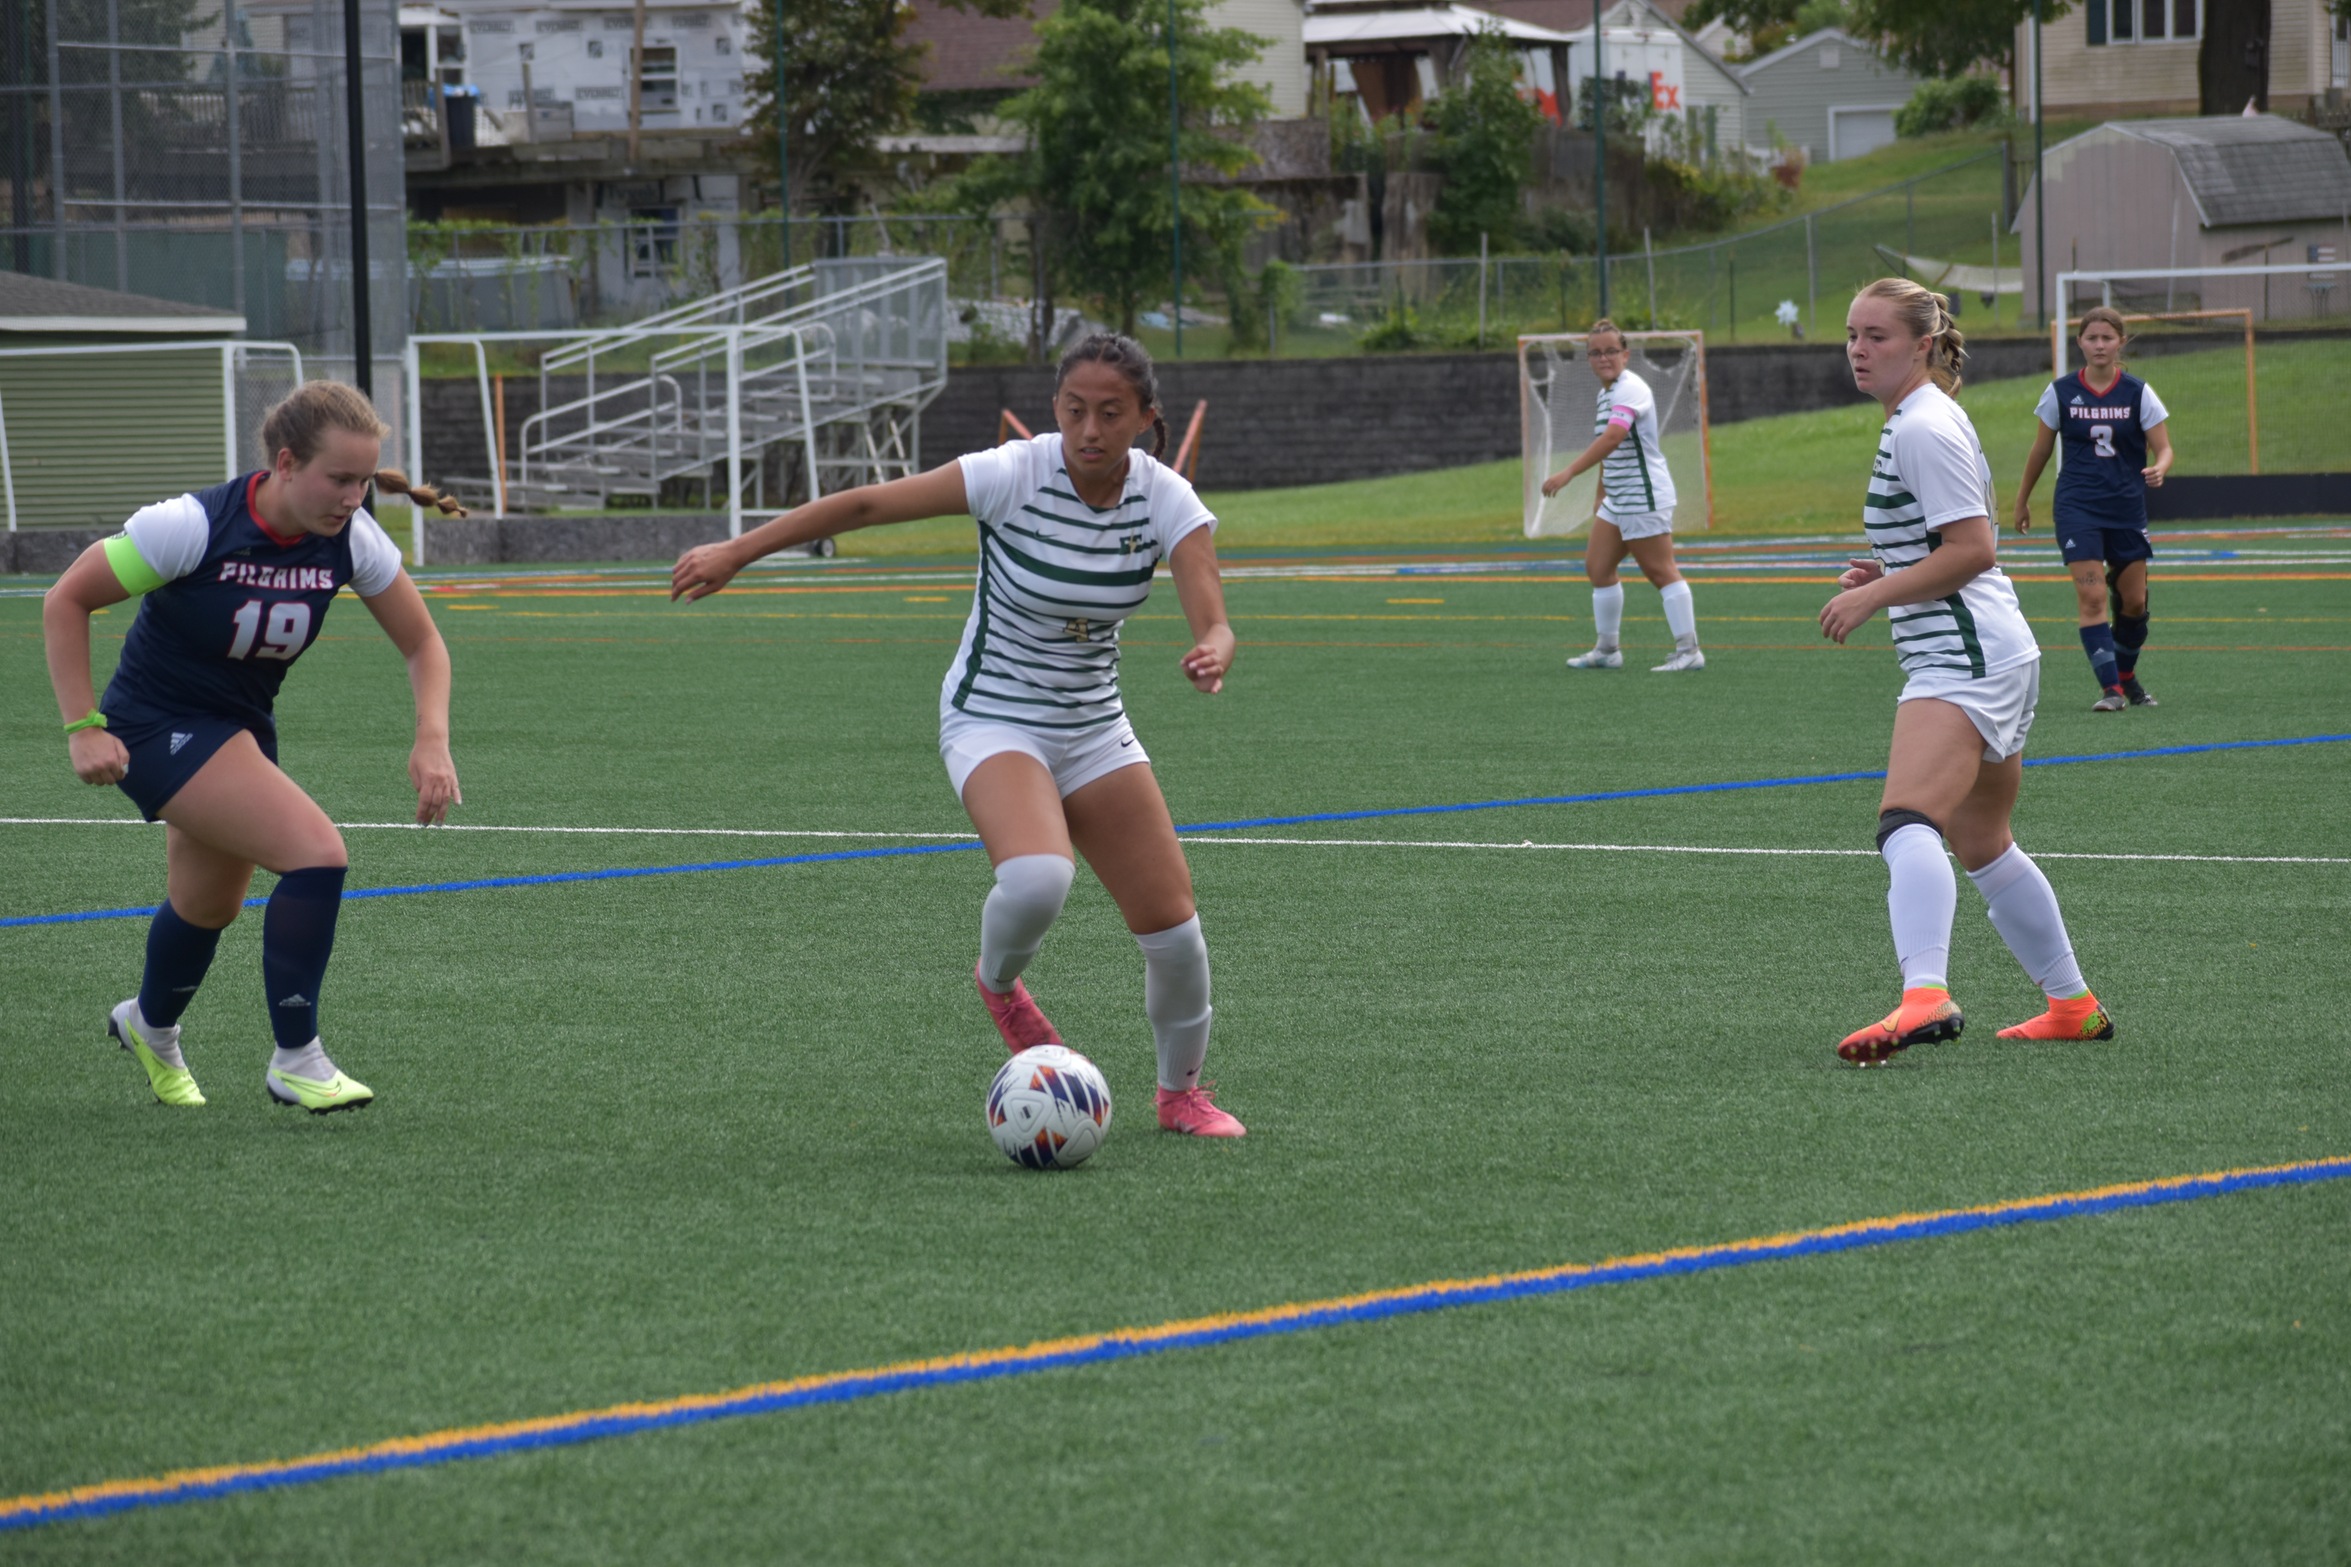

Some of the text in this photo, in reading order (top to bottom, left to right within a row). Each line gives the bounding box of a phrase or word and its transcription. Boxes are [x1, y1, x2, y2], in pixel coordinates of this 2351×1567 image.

[2069, 406, 2131, 419] PILGRIMS
[2090, 425, 2116, 457] 3
[218, 561, 334, 589] PILGRIMS
[226, 599, 311, 661] 19
